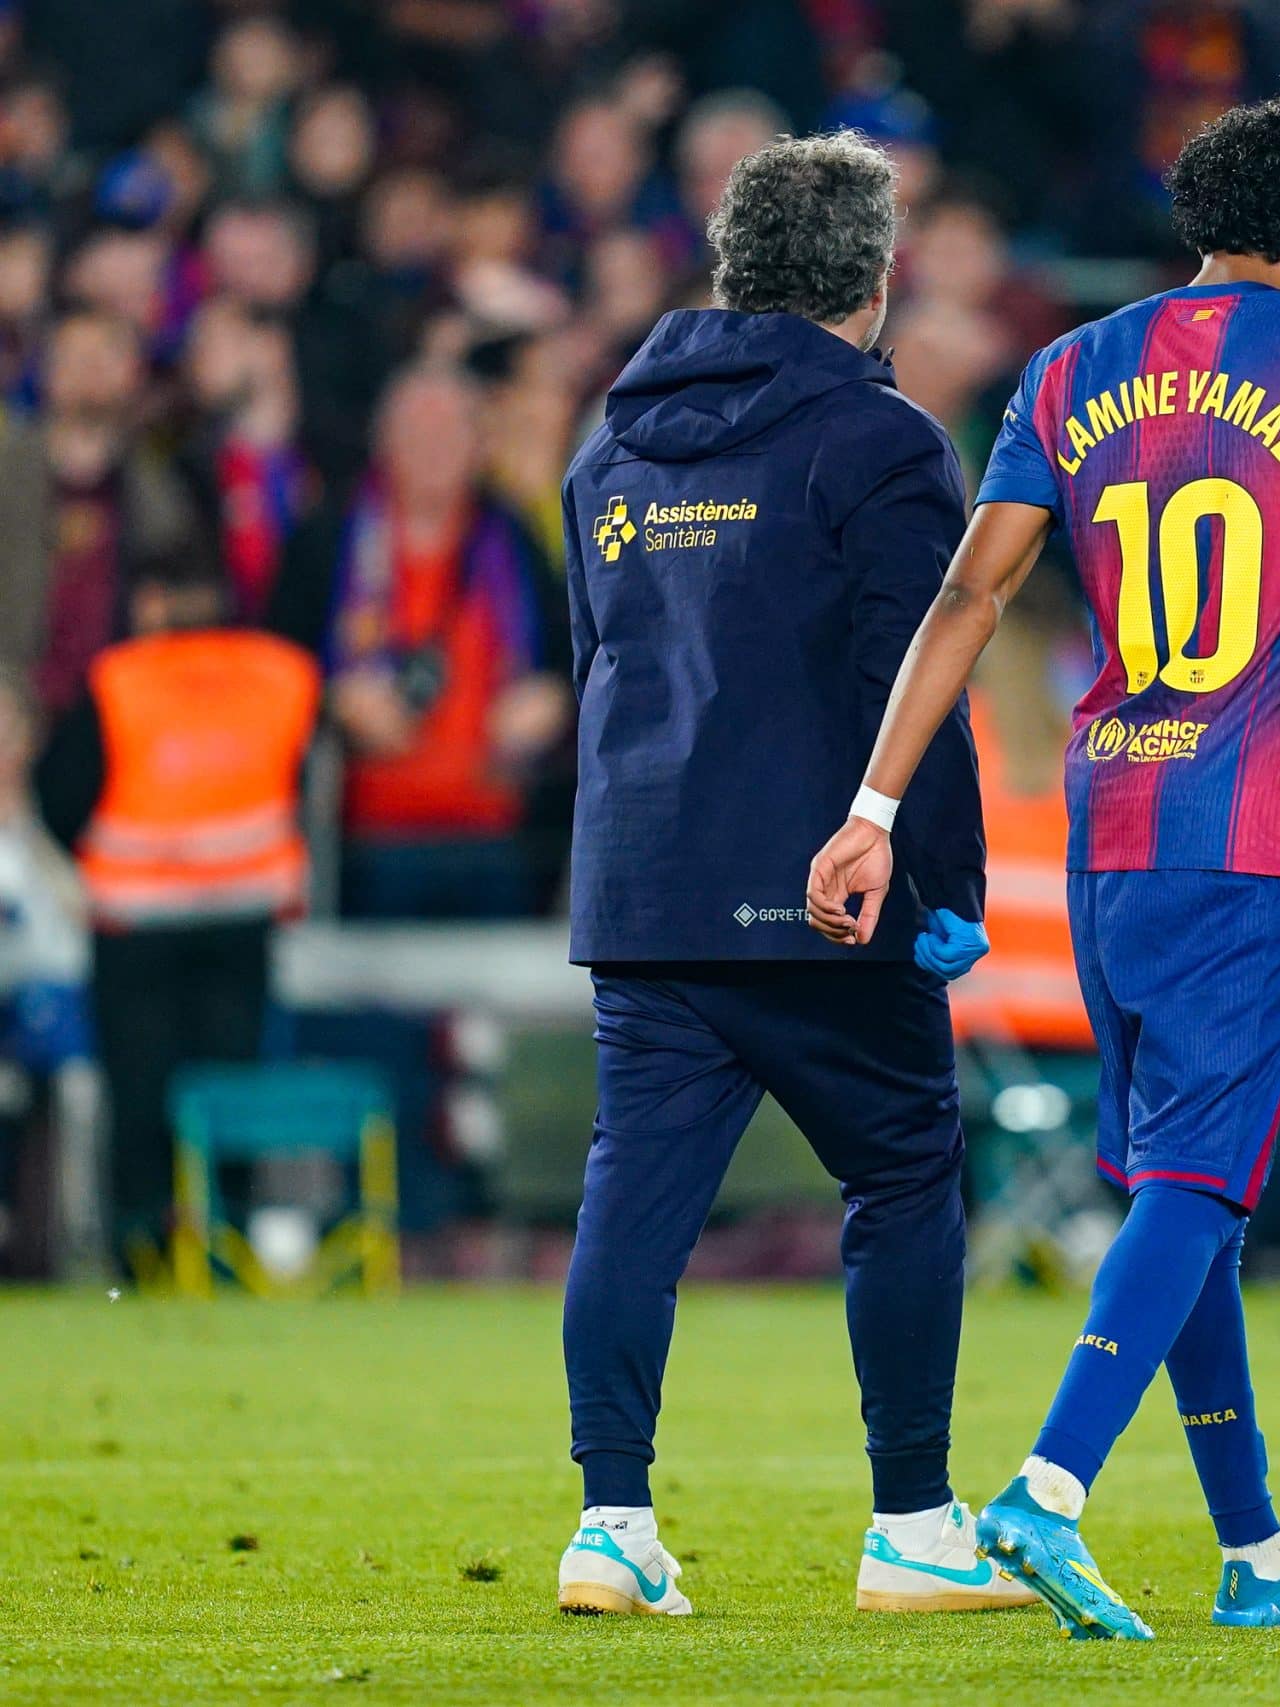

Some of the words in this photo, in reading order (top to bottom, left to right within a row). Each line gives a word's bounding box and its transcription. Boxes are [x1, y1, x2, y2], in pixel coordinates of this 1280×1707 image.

[1057, 371, 1178, 476] LAMINE
[643, 498, 758, 526] Assistència
[644, 523, 717, 552] Sanitària
[1092, 477, 1263, 694] 10
[759, 908, 811, 921] GORE-TE
[1074, 1334, 1118, 1356] ARÇA
